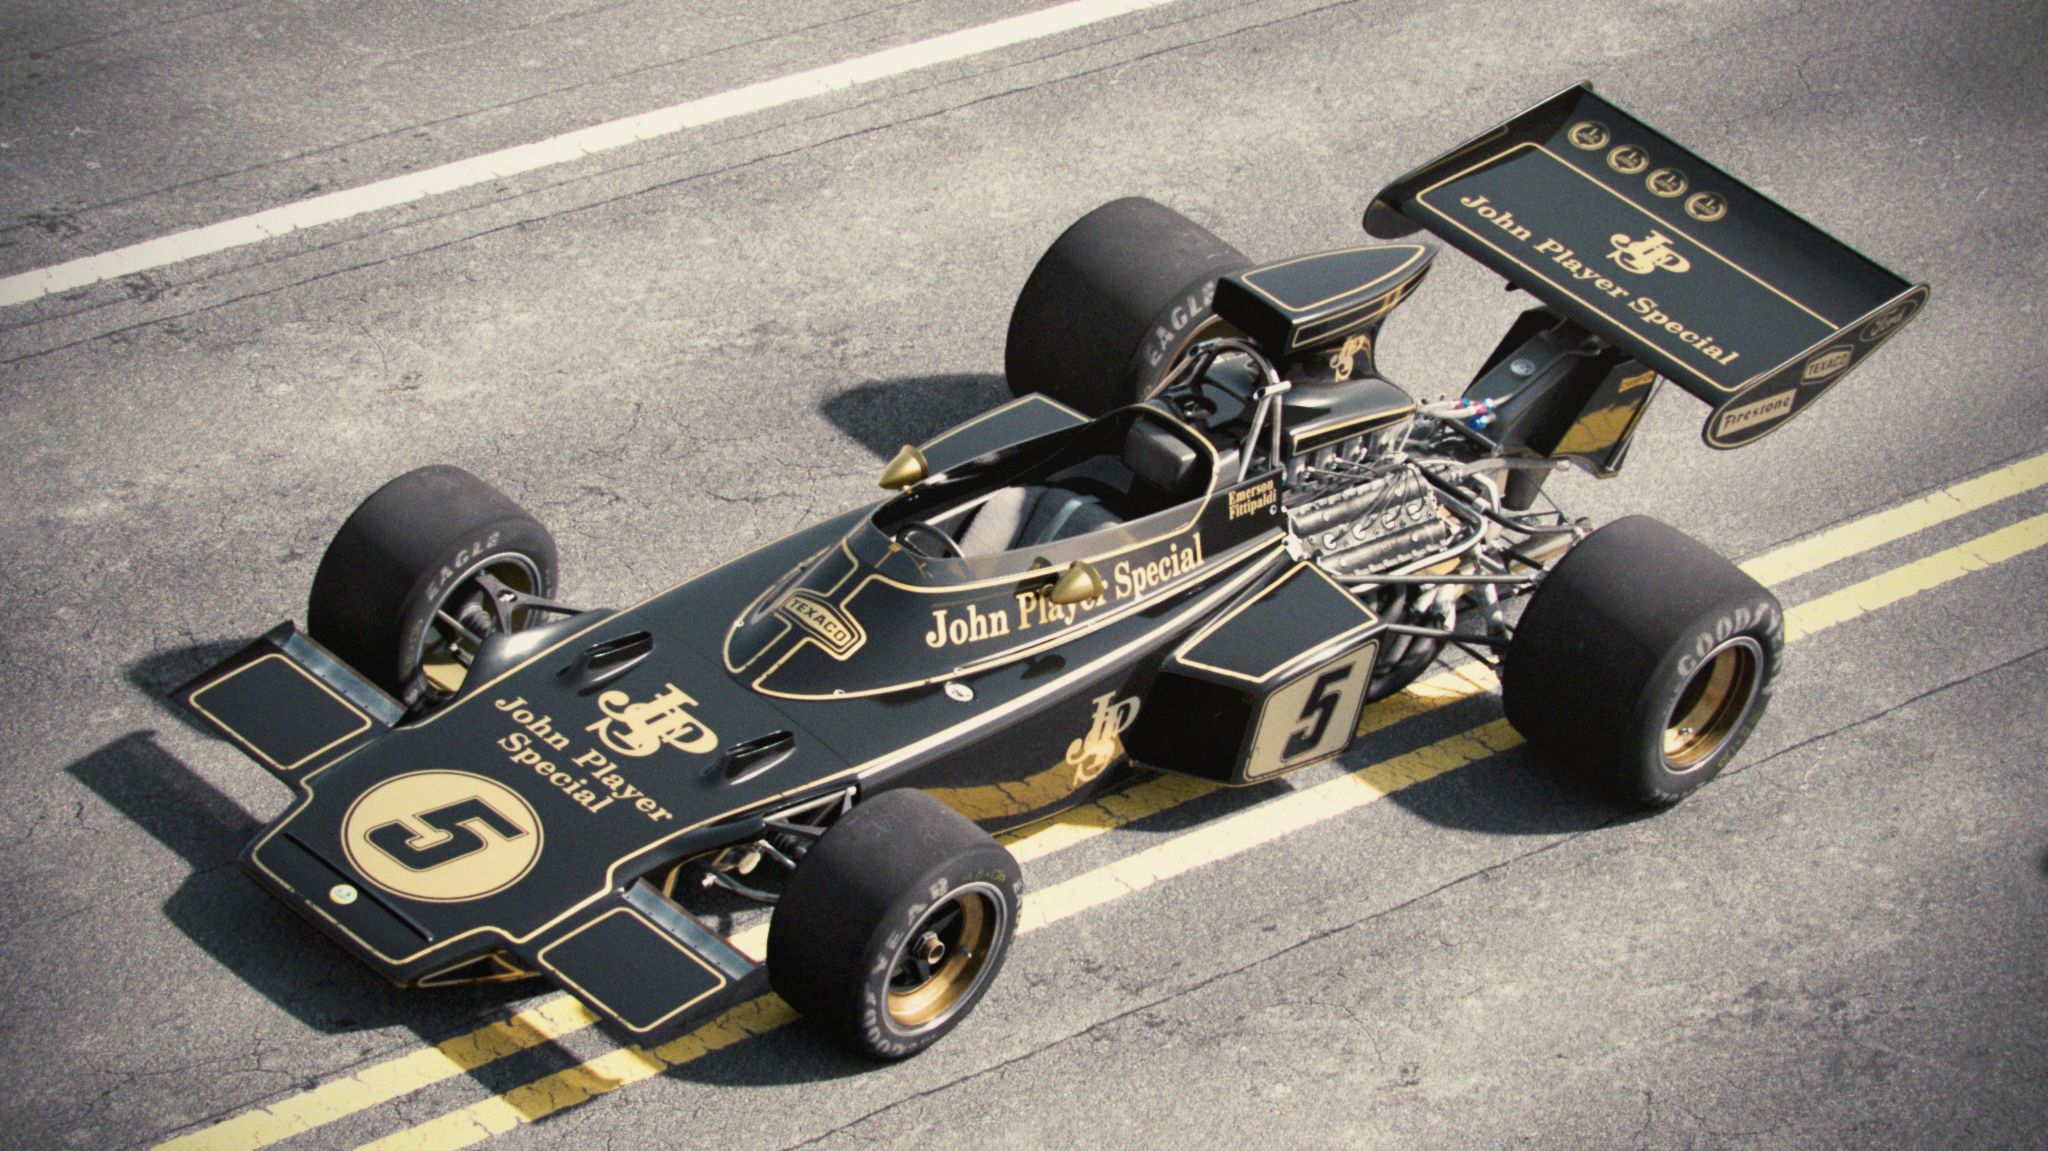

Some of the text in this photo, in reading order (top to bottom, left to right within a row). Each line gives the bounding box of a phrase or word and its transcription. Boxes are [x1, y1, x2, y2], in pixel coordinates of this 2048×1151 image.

[1460, 193, 1741, 367] John Player Special
[1146, 281, 1214, 367] EAGLE
[1807, 353, 1849, 375] TEXACO
[1723, 395, 1792, 430] Firestone
[1228, 480, 1274, 505] Emerson
[1229, 489, 1276, 520] Fittipaldi
[425, 531, 501, 602] EAGLE
[925, 604, 1010, 648] John
[1114, 532, 1204, 600] Special
[790, 600, 847, 641] TEXACO
[1279, 660, 1356, 762] 5
[495, 695, 674, 823] John Player
[497, 732, 616, 815] Special
[363, 795, 530, 873] 5
